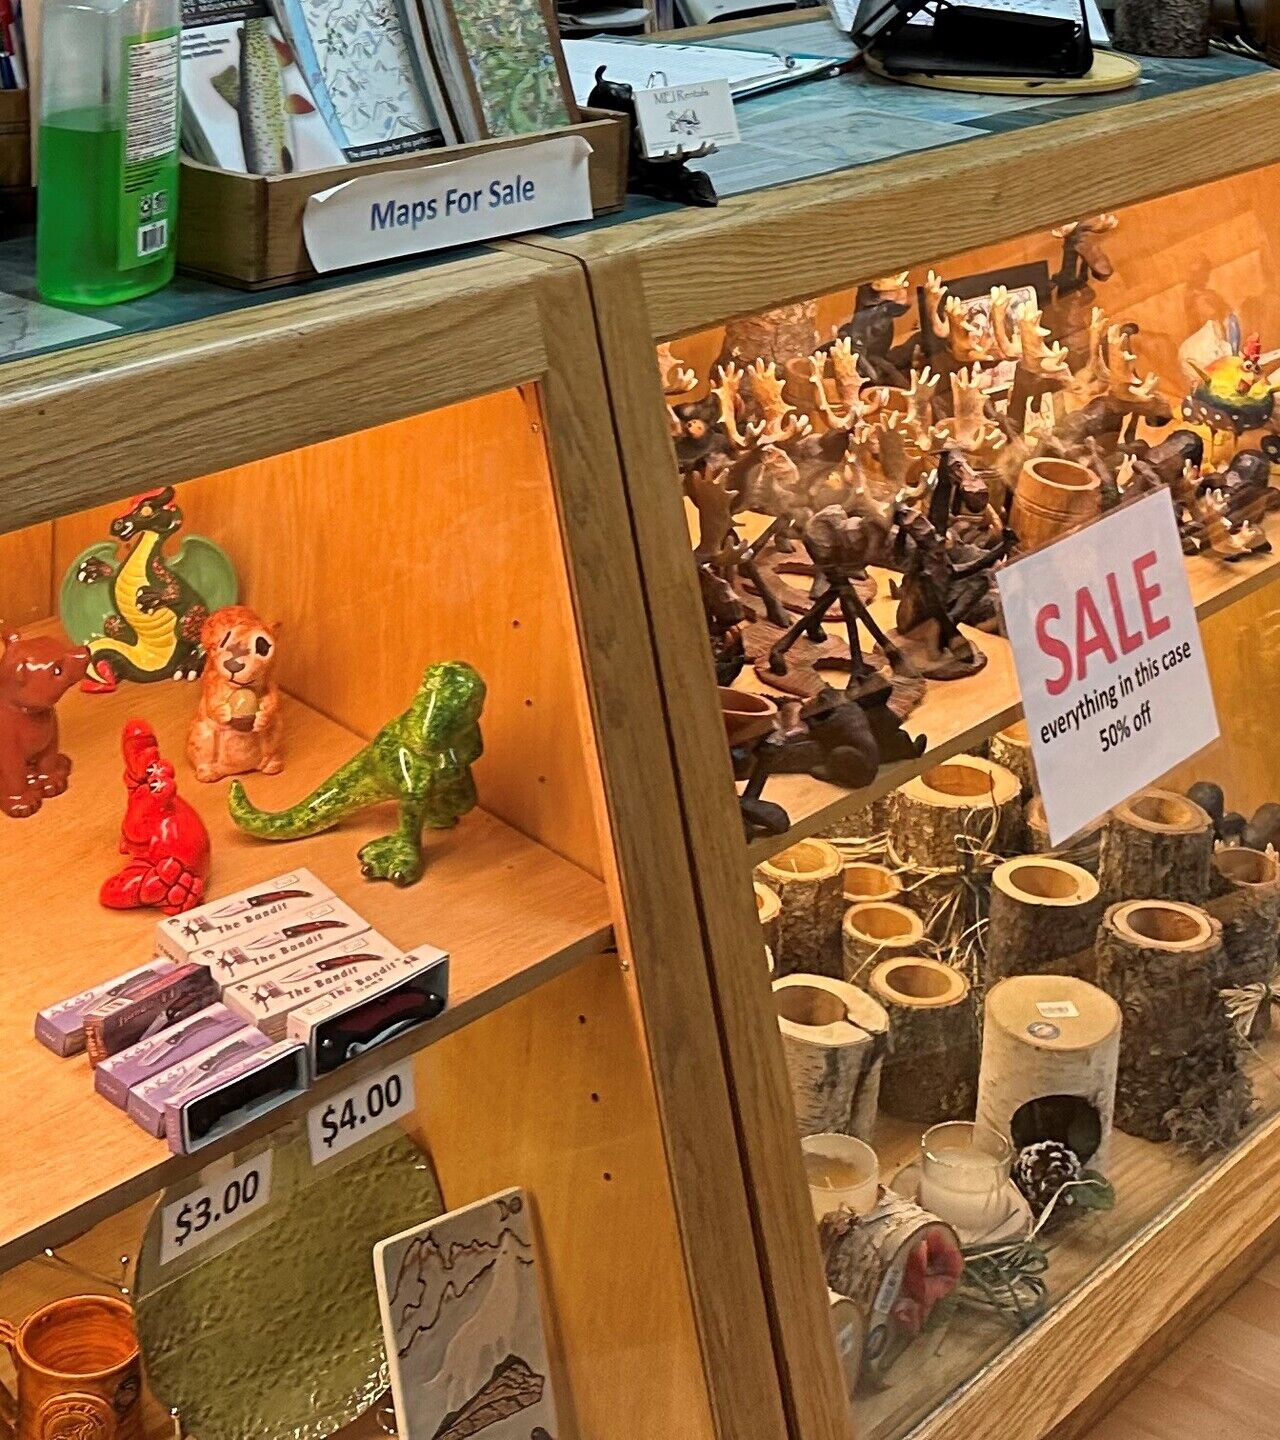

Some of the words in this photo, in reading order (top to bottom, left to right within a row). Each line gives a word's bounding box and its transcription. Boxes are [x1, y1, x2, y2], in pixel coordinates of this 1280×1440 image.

[370, 196, 438, 232] Maps
[444, 187, 483, 218] For
[487, 174, 536, 209] Sale
[1035, 550, 1171, 696] SALE
[1040, 685, 1119, 745] everything
[1118, 675, 1134, 698] in
[1134, 657, 1161, 688] this
[1161, 641, 1193, 673] case
[1099, 715, 1132, 753] 50%
[1132, 699, 1153, 733] off
[216, 919, 241, 935] The
[244, 901, 289, 924] Bandit
[251, 949, 277, 966] The
[279, 931, 325, 956] Bandit
[287, 983, 313, 1000] The
[314, 965, 360, 988] Bandit
[329, 984, 353, 1001] The
[354, 960, 400, 986] Bandit
[322, 1073, 401, 1148] $4.00
[174, 1170, 260, 1247] $3.00
